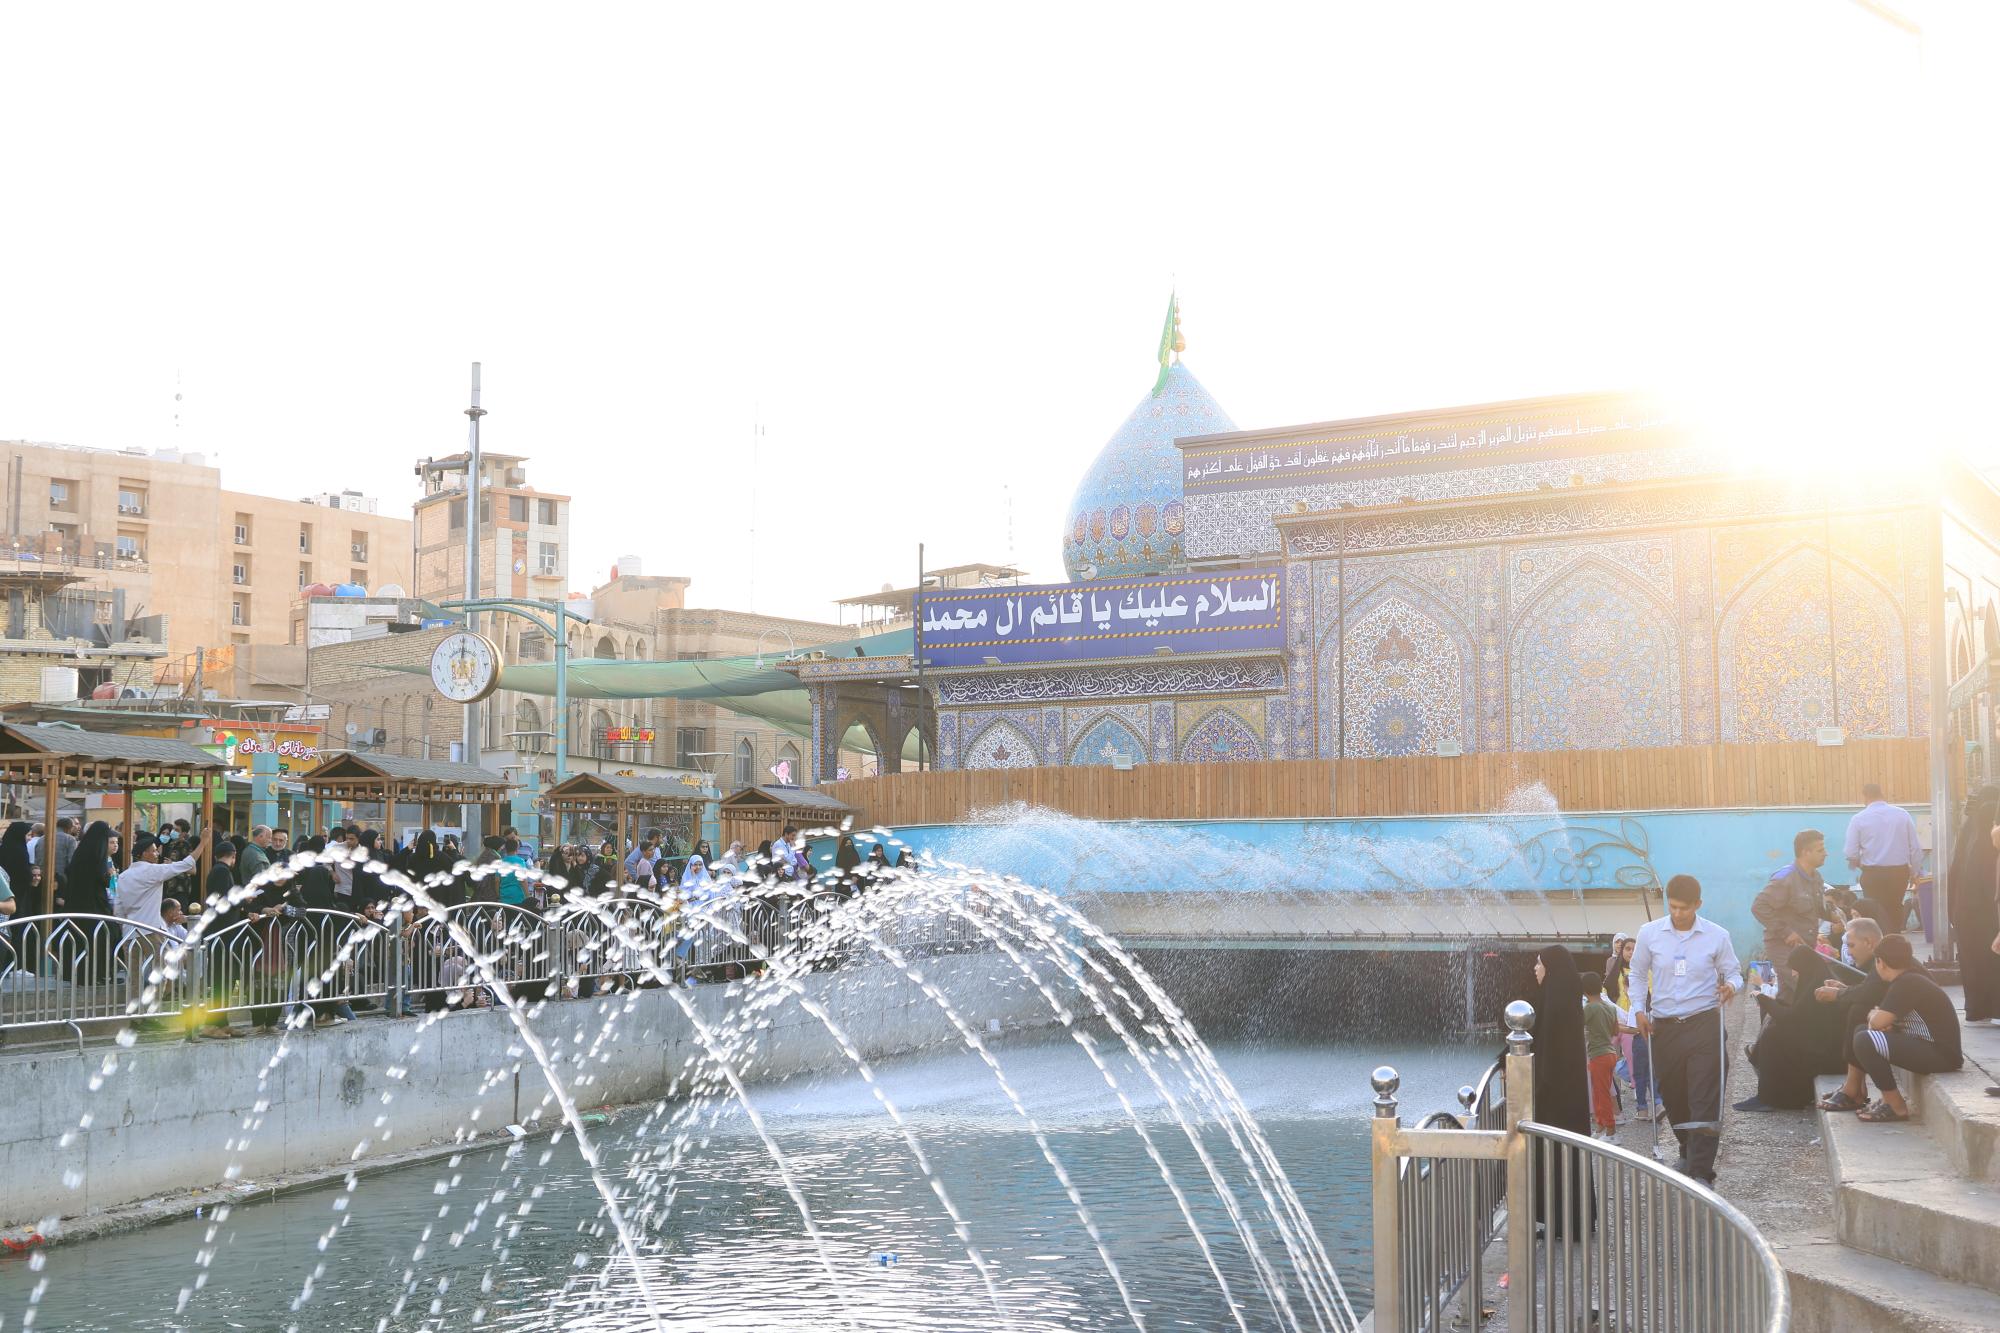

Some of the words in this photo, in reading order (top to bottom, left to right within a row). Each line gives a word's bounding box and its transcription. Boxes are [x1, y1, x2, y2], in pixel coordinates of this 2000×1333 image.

[922, 605, 988, 632] محمد
[995, 596, 1023, 636] ال
[1029, 591, 1084, 636] قائم
[1090, 592, 1112, 630] يا
[1118, 586, 1189, 627] عليك
[1195, 578, 1276, 625] السلام
